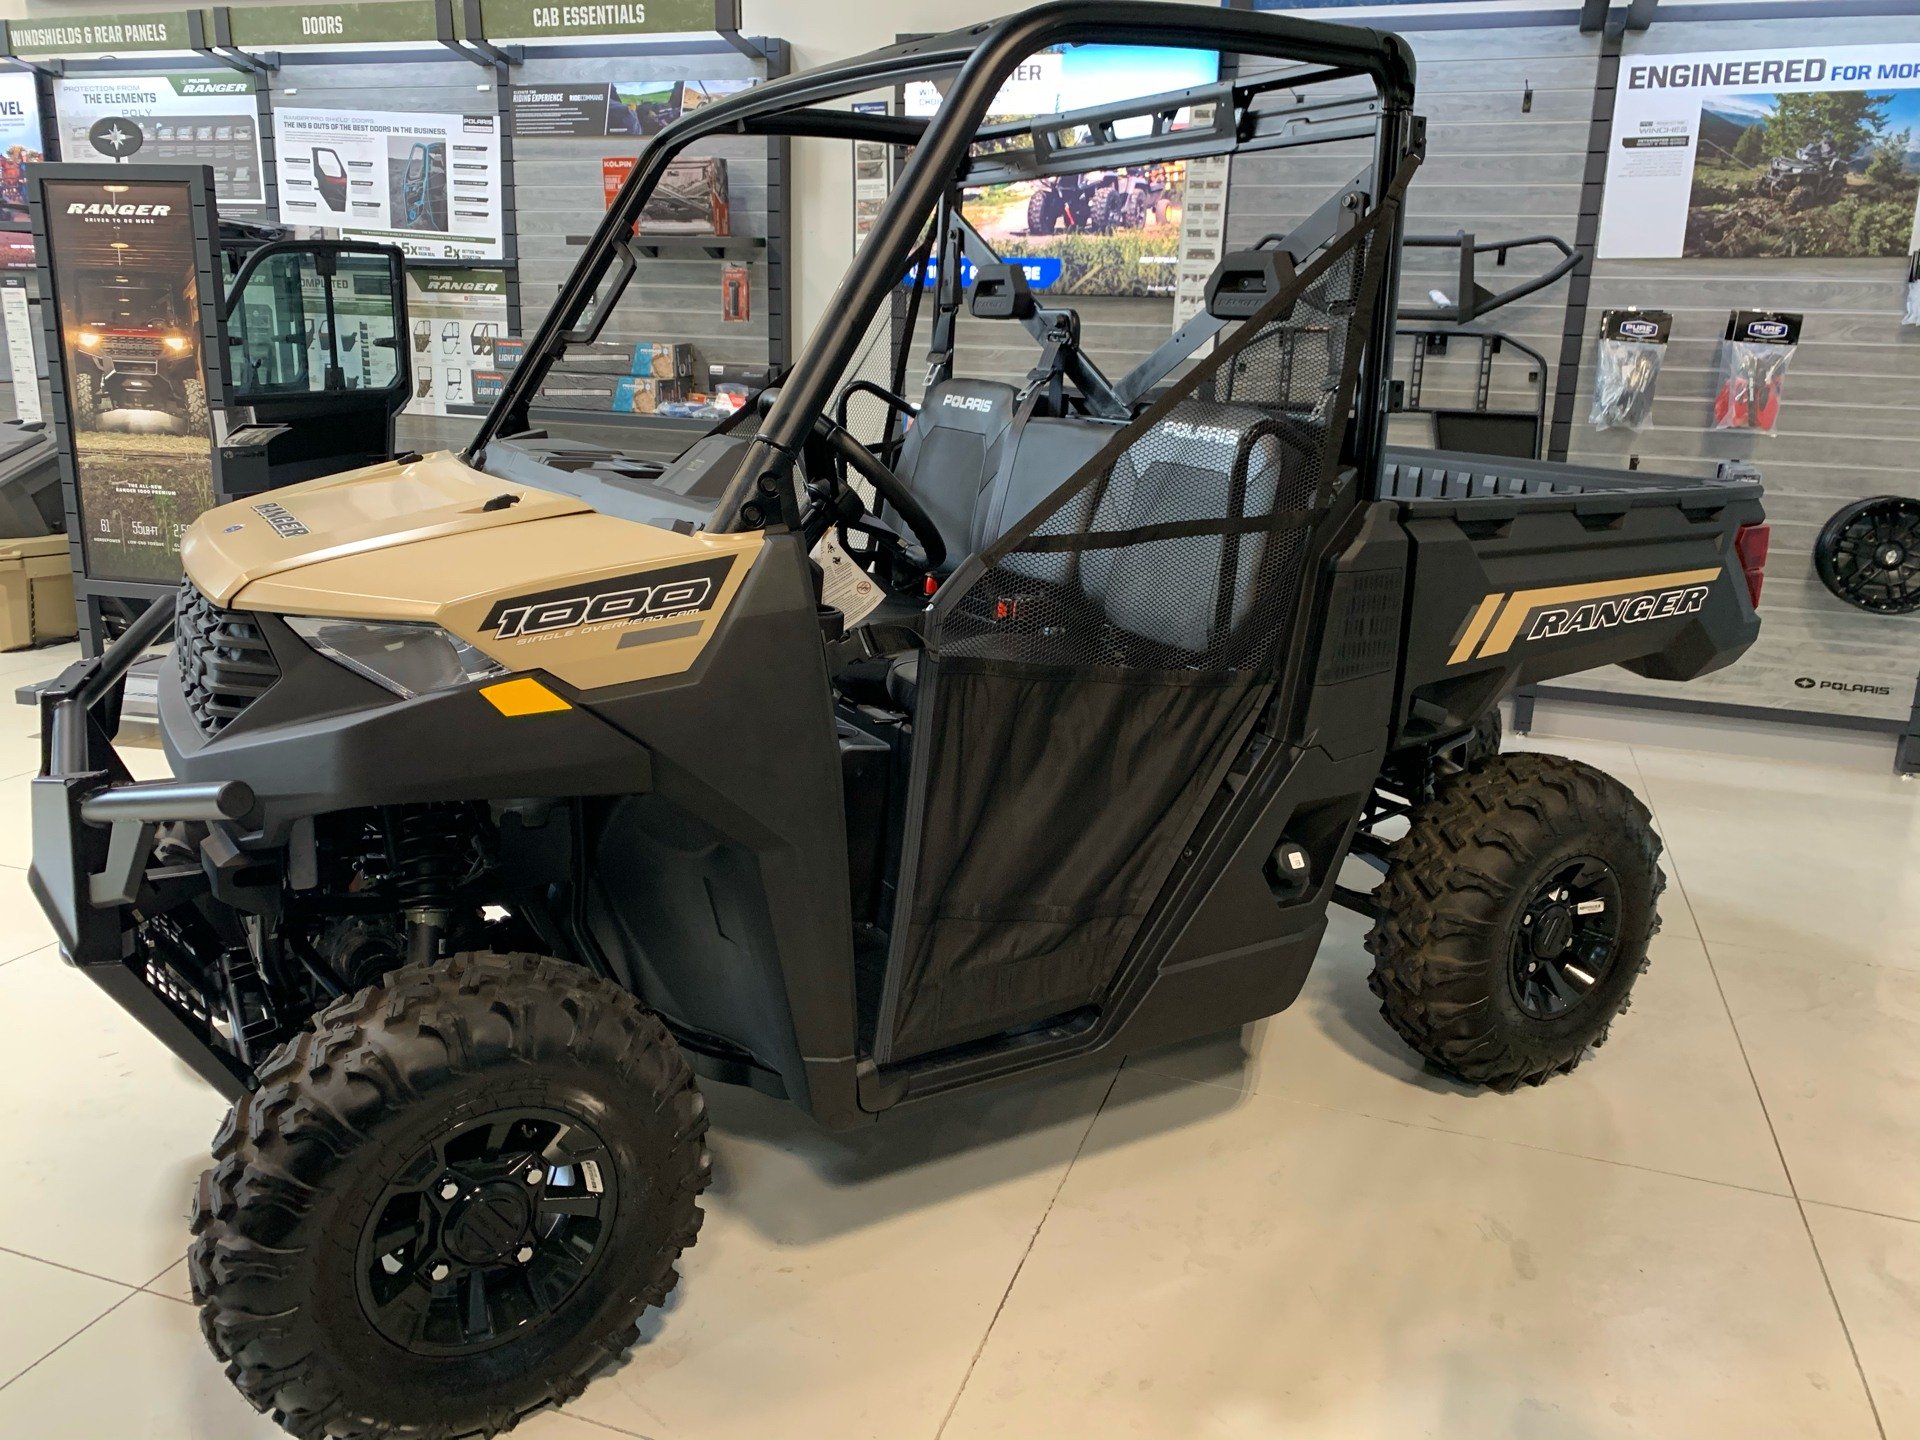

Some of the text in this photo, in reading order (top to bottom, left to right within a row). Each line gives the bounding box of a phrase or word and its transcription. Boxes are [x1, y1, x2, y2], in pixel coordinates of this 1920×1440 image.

[533, 4, 645, 27] CAB ESSENTIALS
[302, 16, 343, 34] DOORS
[11, 24, 167, 46] WINDSHIELDS & REAR PANELS
[1628, 58, 1826, 90] ENGINEERED
[1831, 65, 1872, 81] FOR
[182, 83, 247, 93] RANGER
[83, 92, 157, 104] THE ELEMENTS
[532, 93, 563, 102] EXPERIENCE
[121, 109, 152, 118] POLY
[370, 125, 391, 133] DOORS
[67, 203, 171, 216] RANGER
[427, 281, 498, 291] RANGER
[1626, 324, 1653, 332] PURE
[1753, 324, 1782, 332] PURE
[477, 387, 494, 395] LIGHT
[943, 394, 992, 413] POLARIS
[100, 519, 110, 532] 61
[250, 502, 310, 539] RANGER
[493, 578, 711, 640] 1000
[1527, 586, 1709, 641] RANGER
[516, 608, 700, 645] SINGLE OVERHEAD CAM
[1820, 681, 1890, 695] POLARIS
